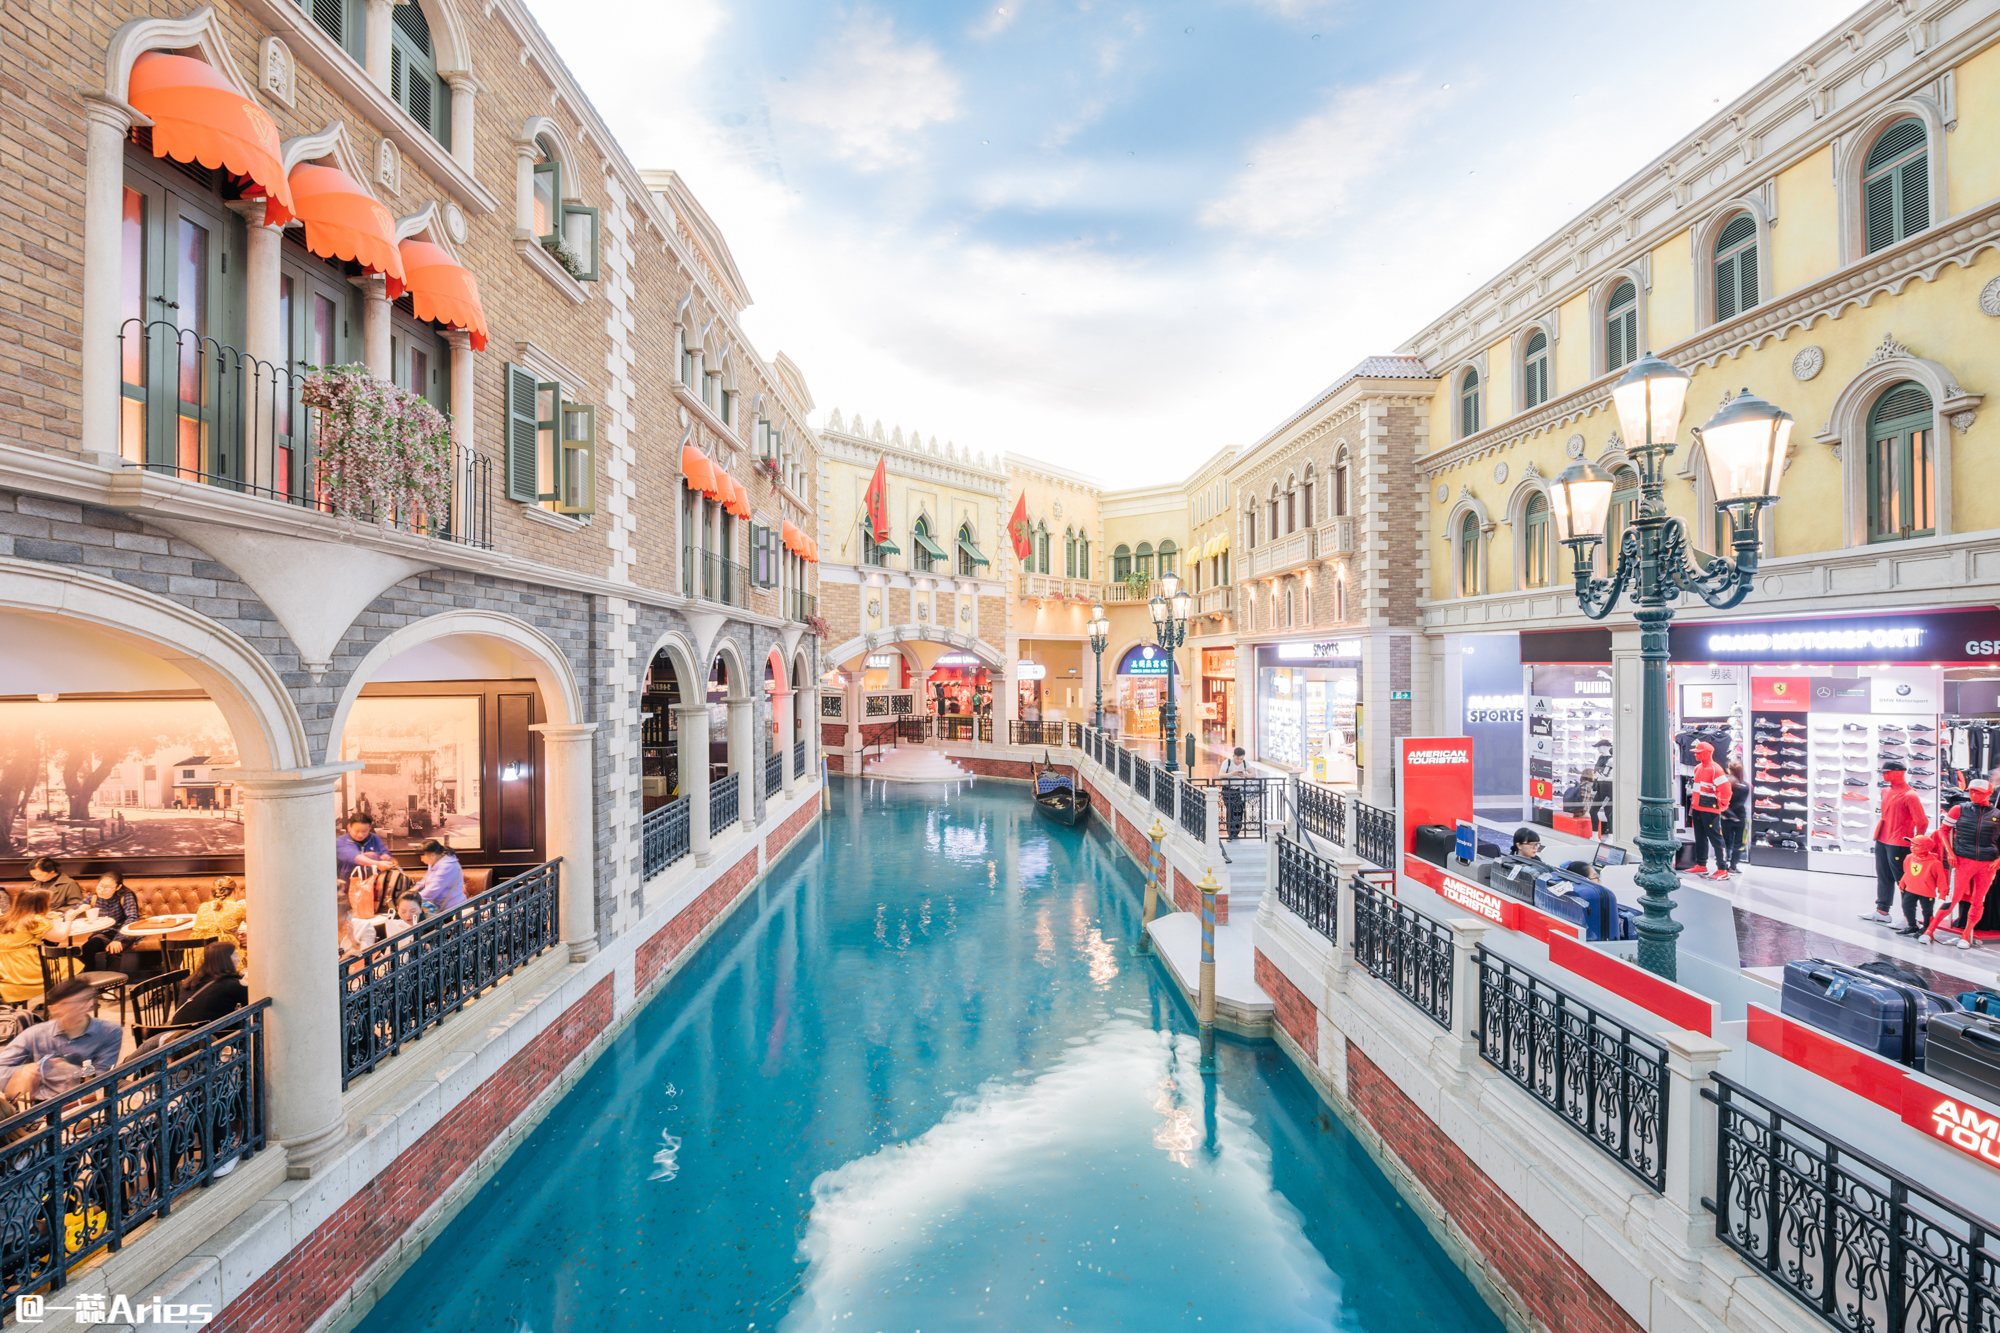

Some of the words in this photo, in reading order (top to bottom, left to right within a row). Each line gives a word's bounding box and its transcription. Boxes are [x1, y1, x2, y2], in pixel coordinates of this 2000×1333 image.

[1772, 628, 1920, 650] MOTORSPORT
[1711, 668, 1732, 680] 男装
[1574, 681, 1611, 694] PUMA
[1469, 709, 1524, 723] SPORTS
[1407, 750, 1467, 758] AMERICAN
[1443, 877, 1501, 911] AMERICAN
[1933, 1100, 2000, 1143] AM
